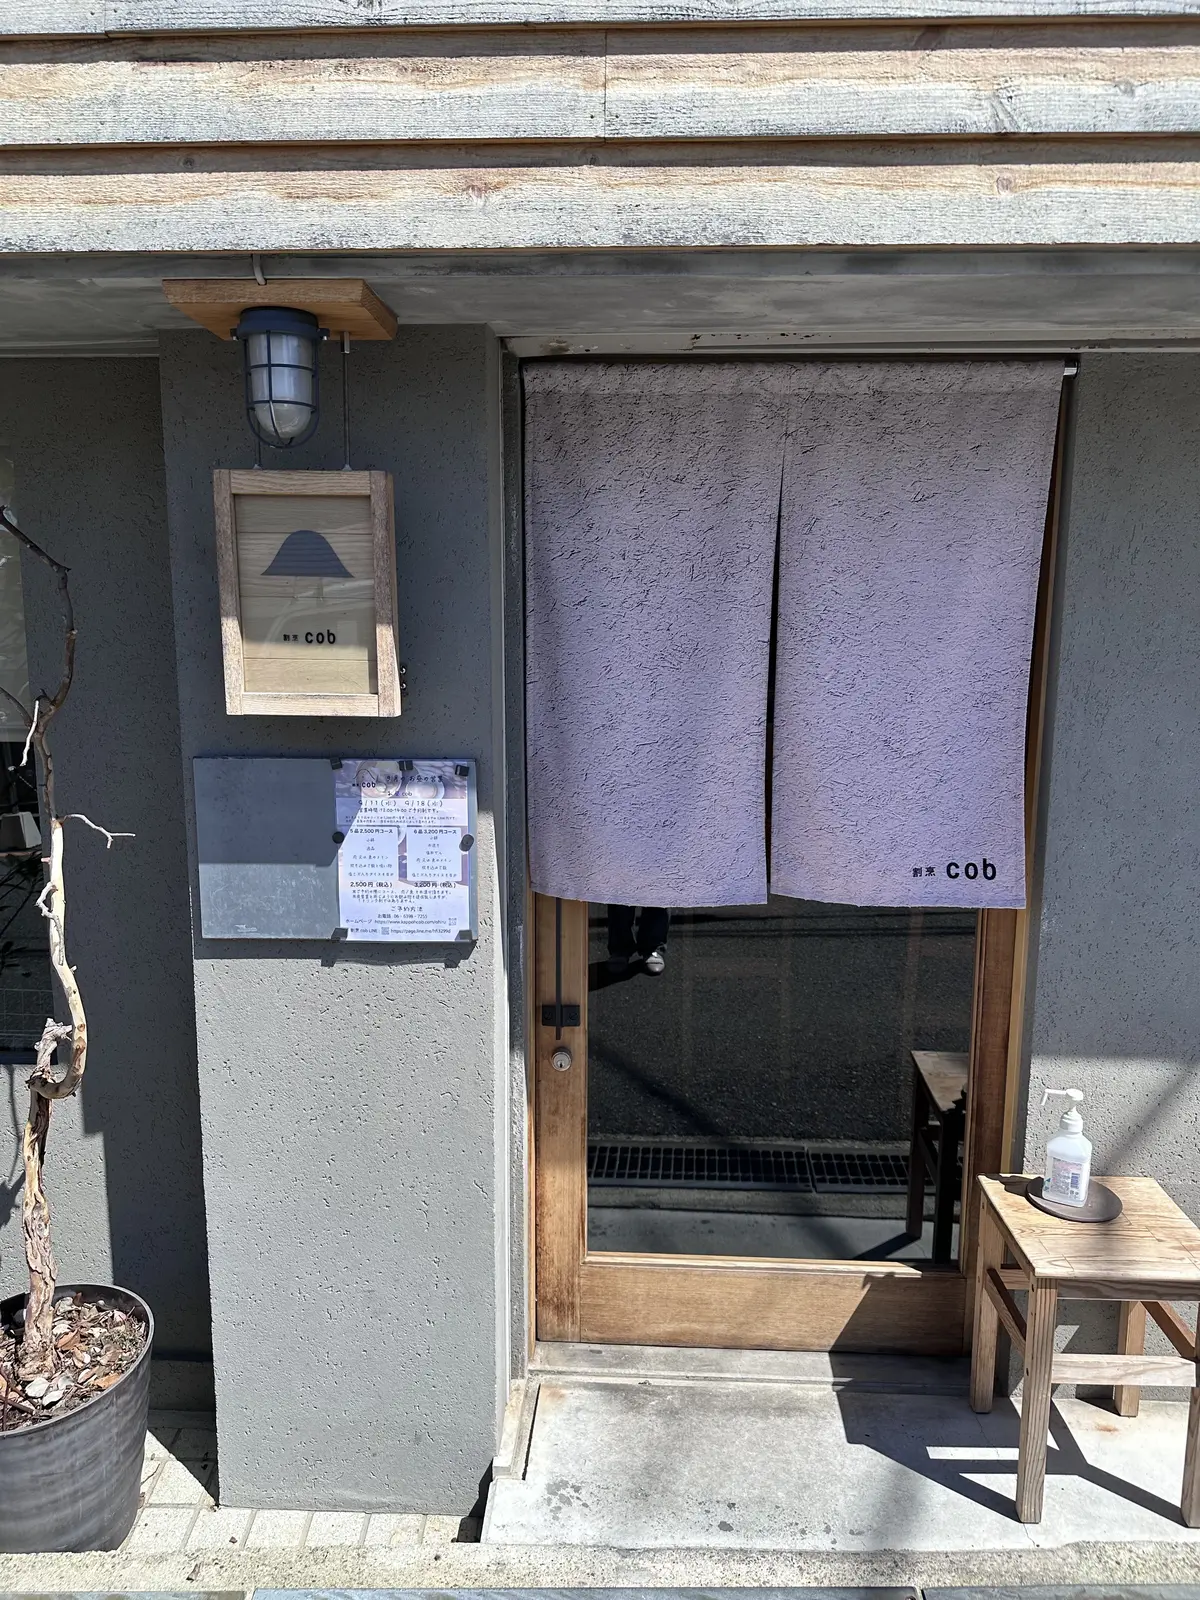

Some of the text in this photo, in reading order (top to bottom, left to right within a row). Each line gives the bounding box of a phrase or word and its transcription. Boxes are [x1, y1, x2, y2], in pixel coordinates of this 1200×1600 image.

[305, 629, 336, 644] cob
[912, 857, 997, 881] 割烹 cob
